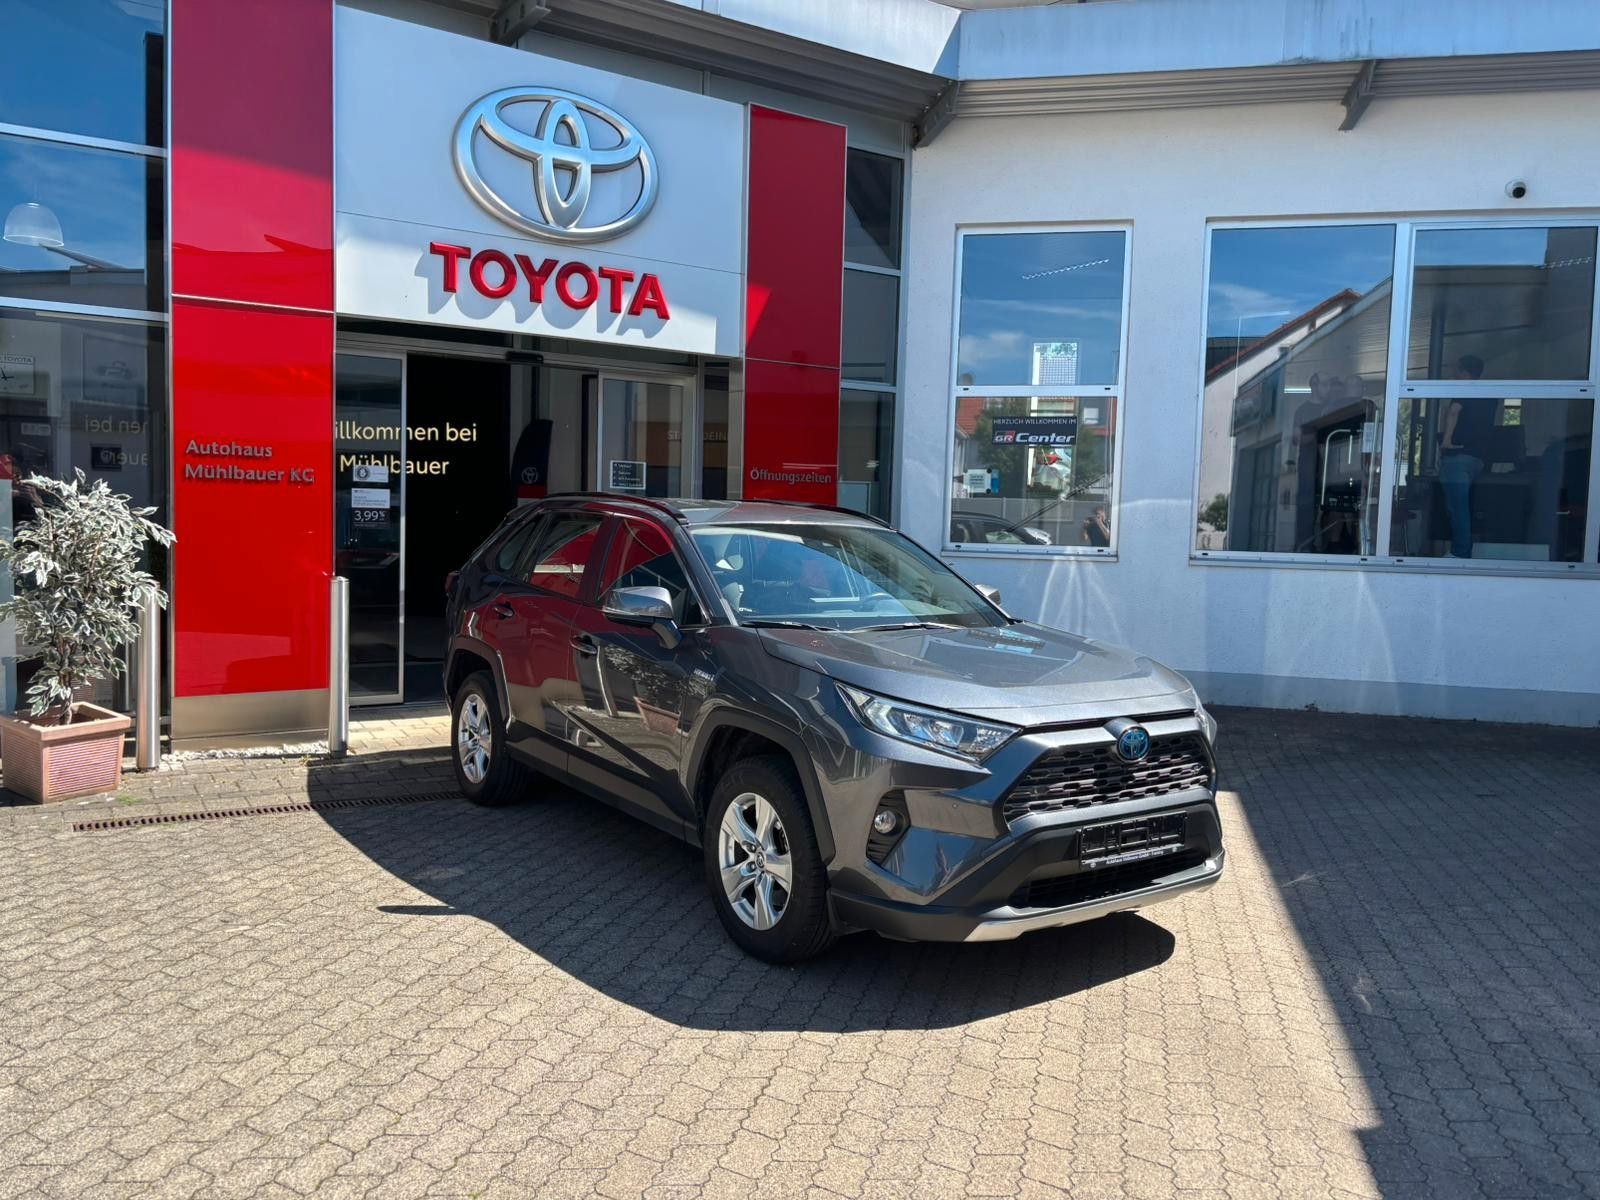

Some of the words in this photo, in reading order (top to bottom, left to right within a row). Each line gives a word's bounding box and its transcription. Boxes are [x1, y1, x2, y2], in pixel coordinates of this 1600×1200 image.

[430, 242, 670, 320] TOYOTA
[335, 420, 439, 441] illkommen
[446, 421, 477, 442] bei
[1015, 432, 1075, 443] Center
[185, 439, 273, 458] Autohaus
[184, 463, 285, 482] Mühlbauer
[289, 467, 315, 484] KG
[750, 466, 832, 485] Öffnungszeiten
